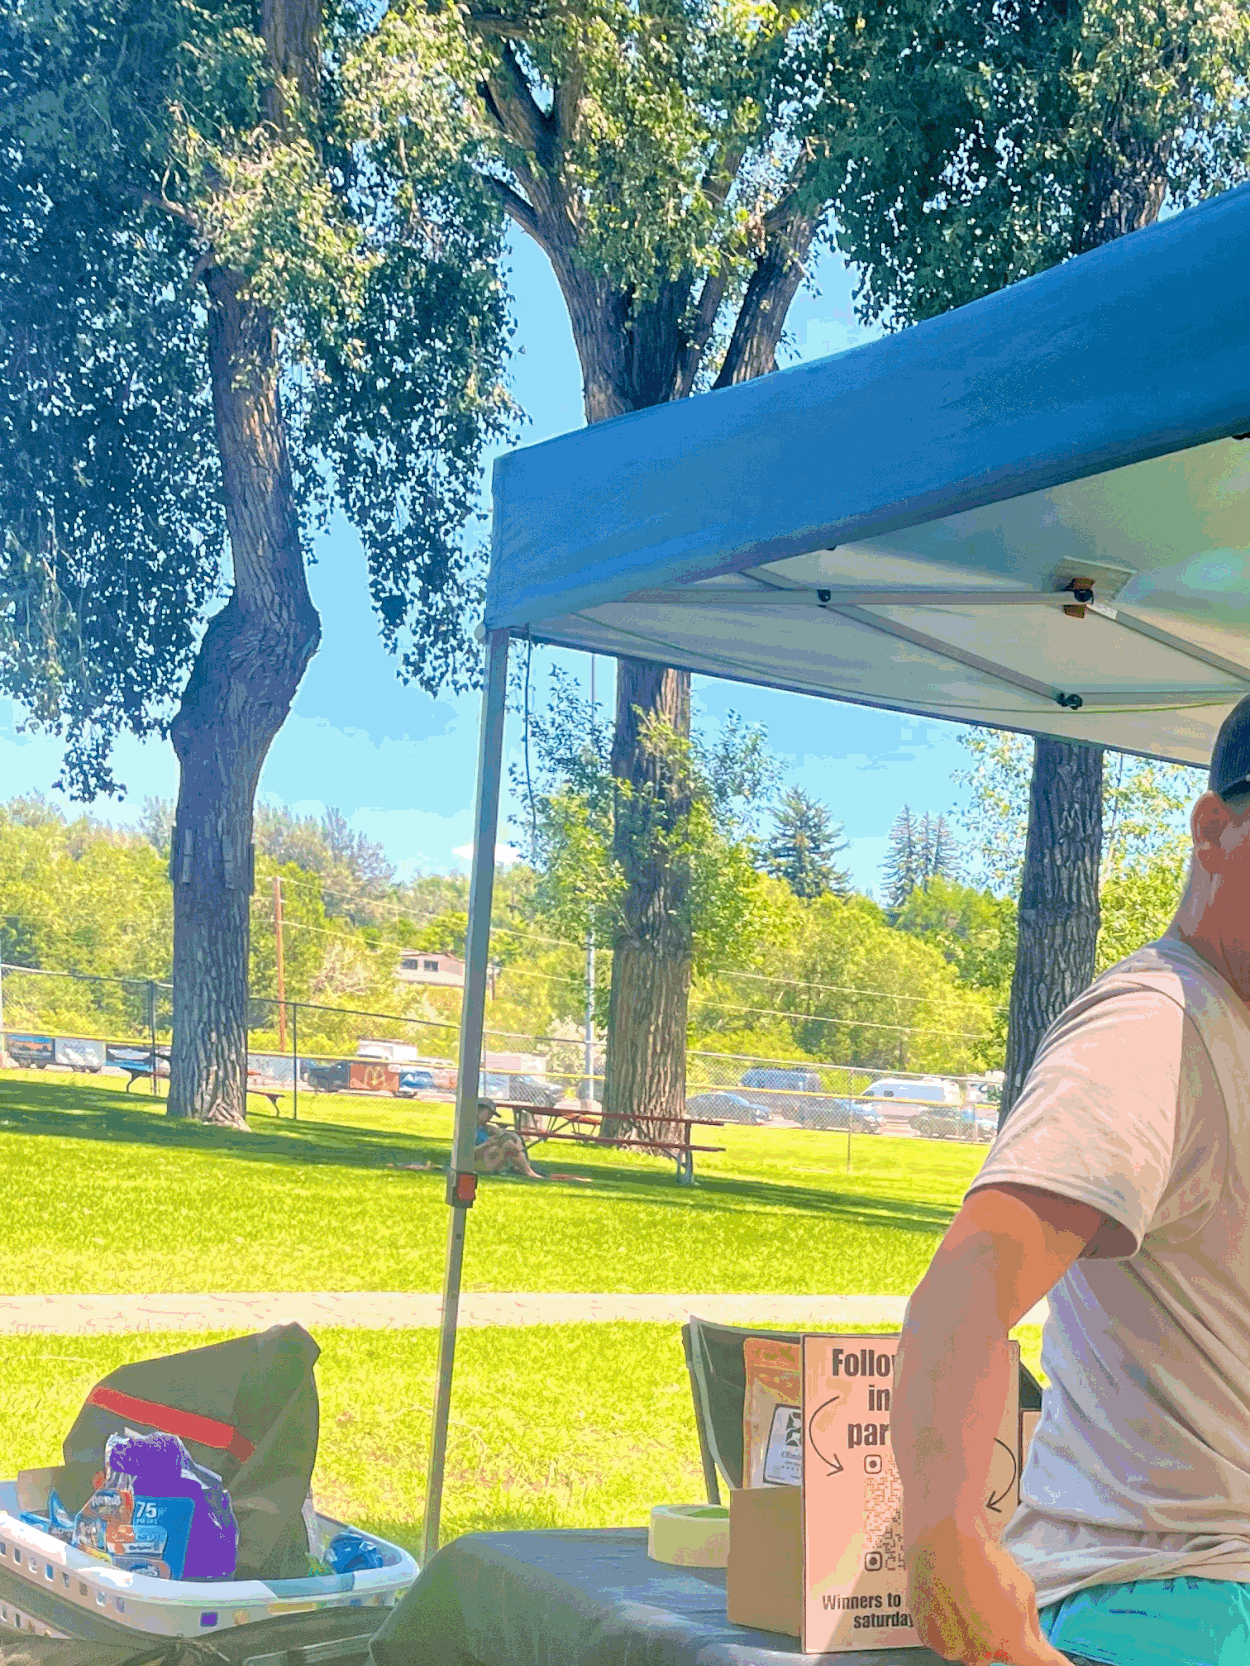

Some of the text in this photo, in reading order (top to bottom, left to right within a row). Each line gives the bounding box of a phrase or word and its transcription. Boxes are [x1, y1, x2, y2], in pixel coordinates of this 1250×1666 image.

[135, 1501, 158, 1519] 75
[822, 1592, 902, 1611] Winners to
